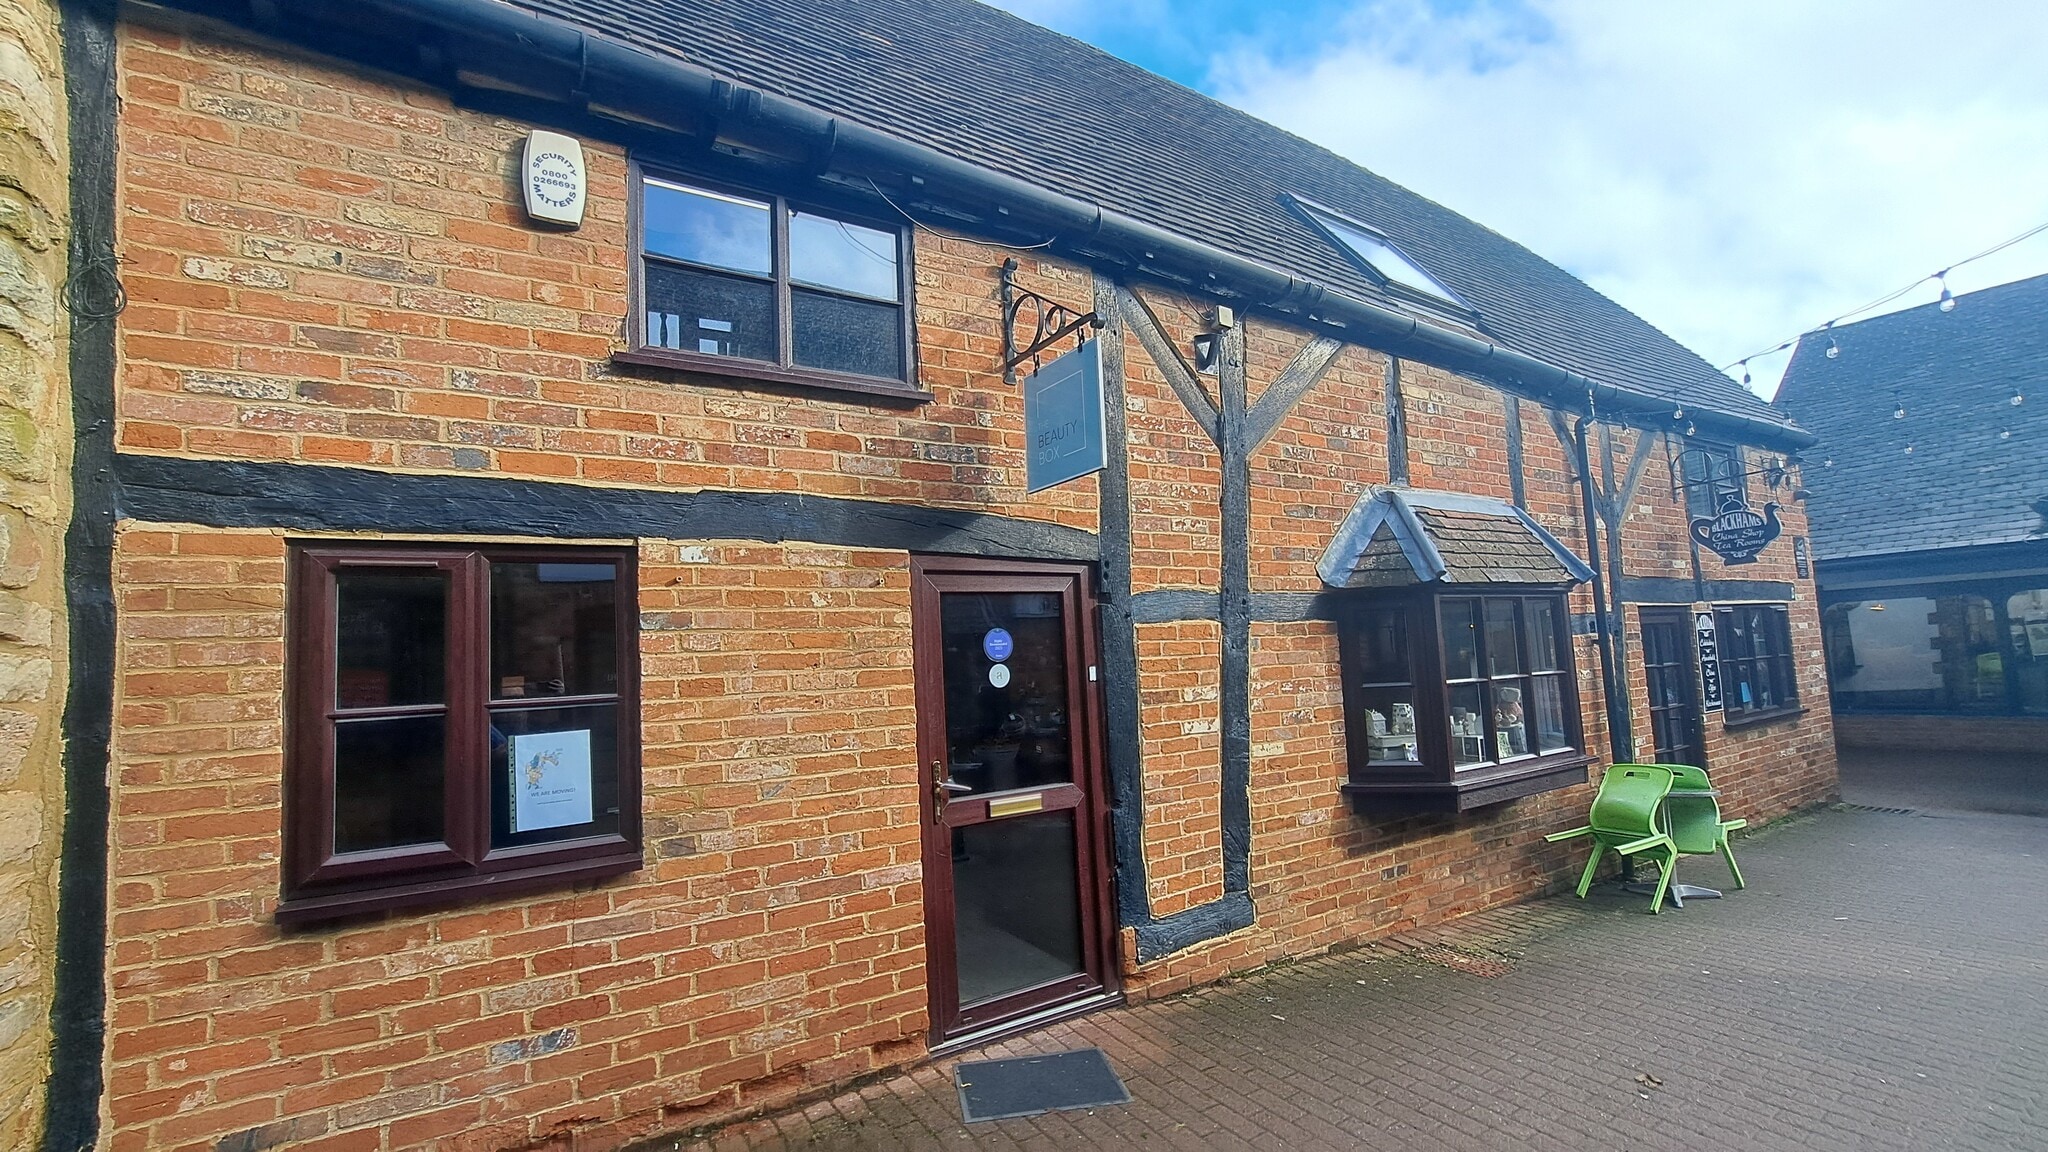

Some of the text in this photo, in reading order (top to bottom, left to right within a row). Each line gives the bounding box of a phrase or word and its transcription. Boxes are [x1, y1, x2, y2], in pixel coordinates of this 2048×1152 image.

[532, 152, 577, 177] SECURITY
[541, 169, 568, 180] 0800
[533, 175, 576, 190] 0266693
[533, 184, 576, 207] MATTERS
[1038, 419, 1077, 449] BEAUTY
[1038, 445, 1060, 466] BOX
[1711, 512, 1762, 533] BLACKHAMS
[1712, 528, 1765, 542] China Shop
[1712, 538, 1766, 550] Tea Rooms
